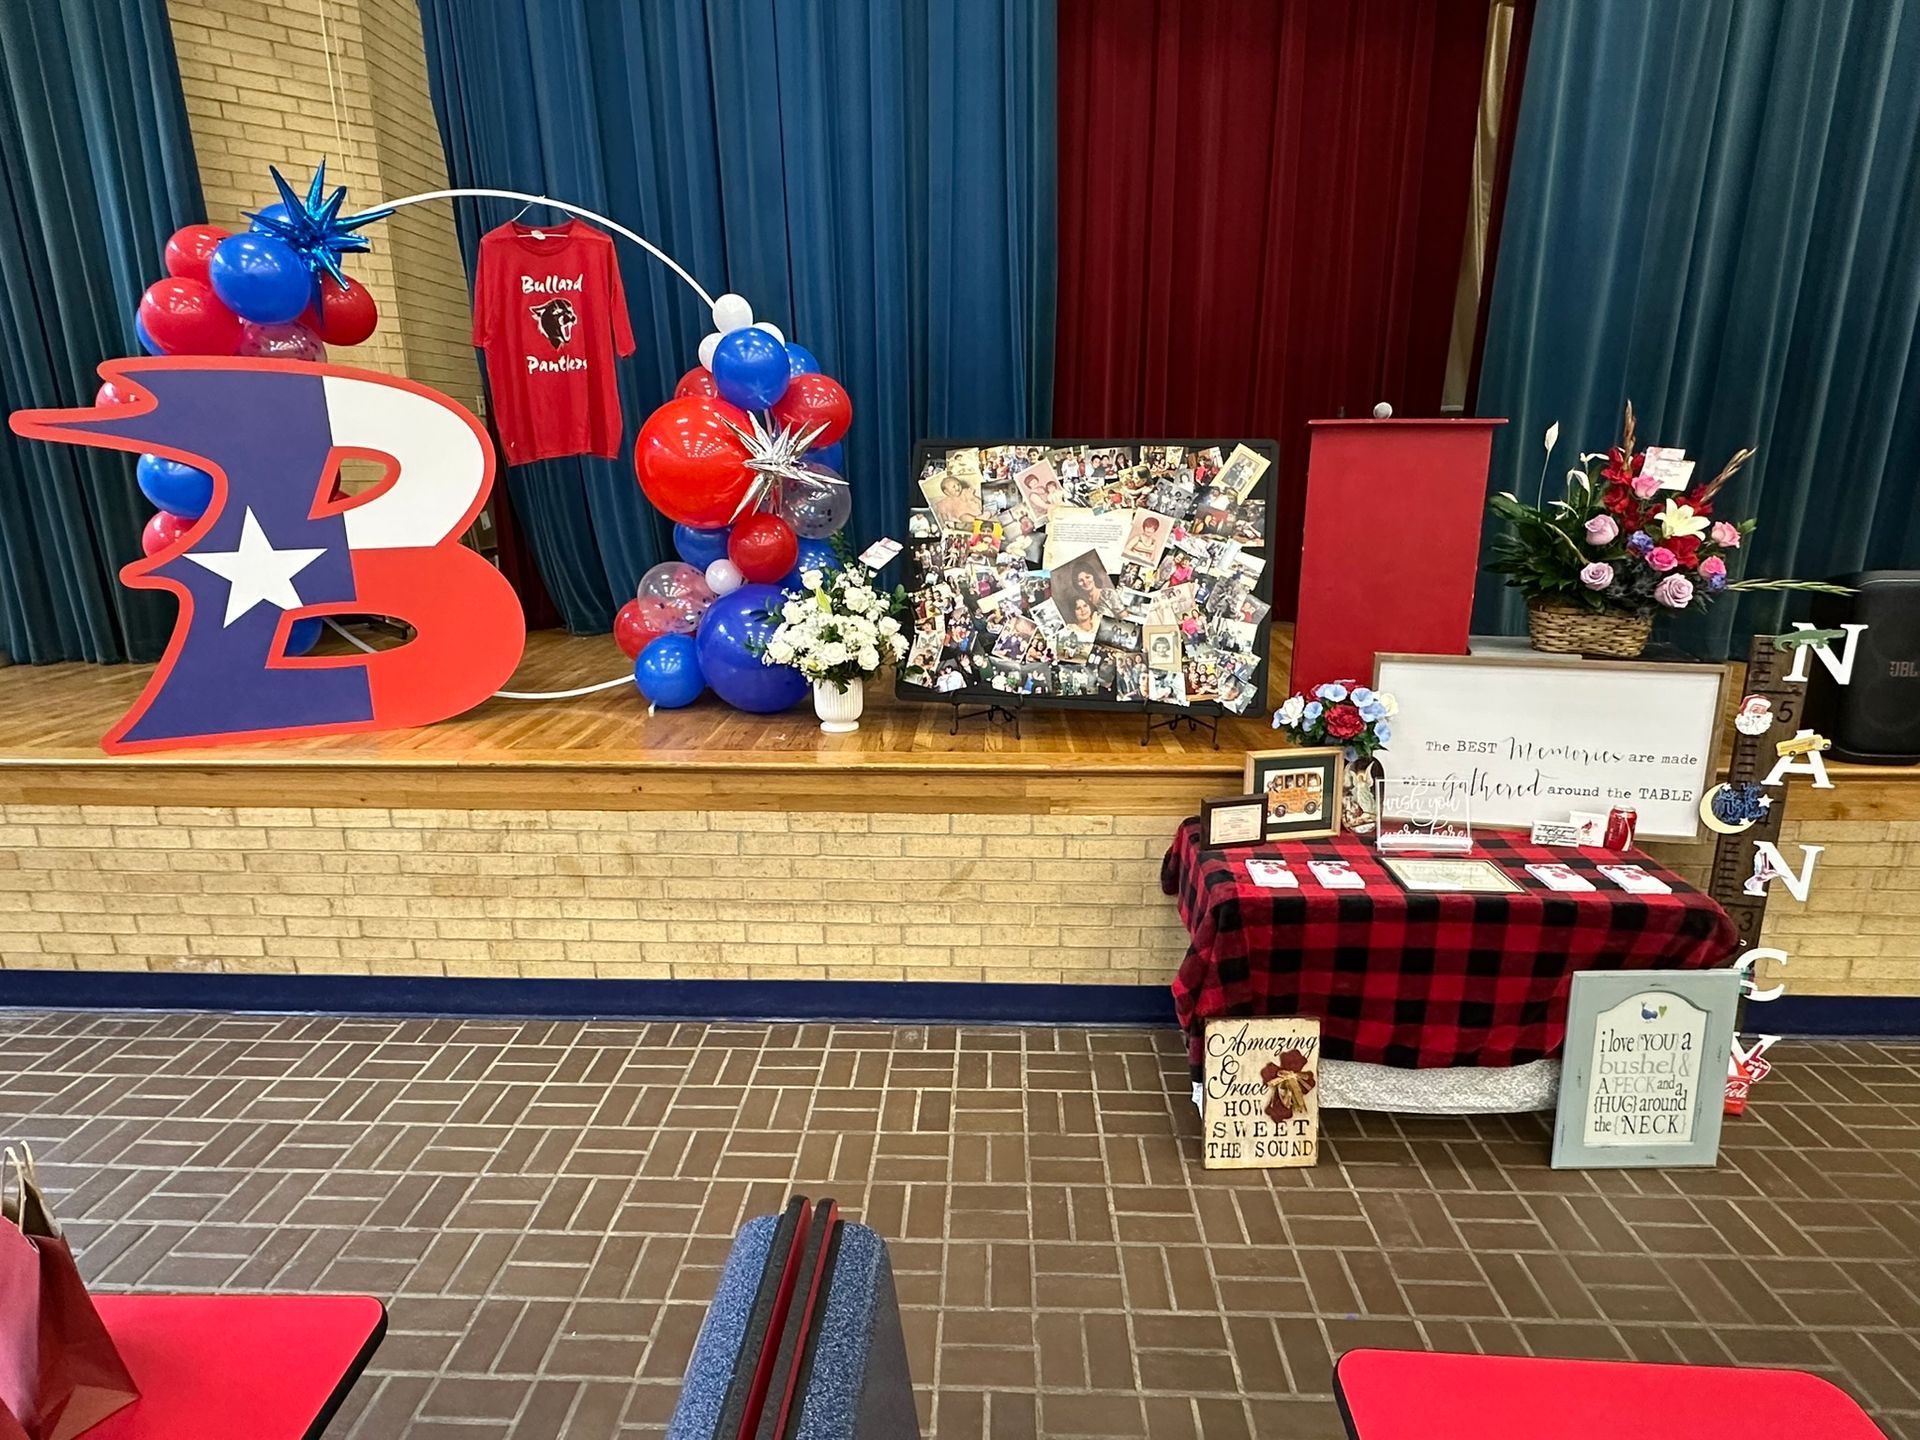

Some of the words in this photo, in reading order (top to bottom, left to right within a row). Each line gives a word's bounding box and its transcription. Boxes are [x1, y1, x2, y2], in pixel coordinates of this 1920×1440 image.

[521, 274, 583, 294] Bullard
[1889, 661, 1918, 677] JBL
[1776, 701, 1794, 724] 5
[1425, 741, 1450, 752] The
[1457, 740, 1498, 754] BEST
[1502, 736, 1624, 766] Memories
[1628, 753, 1655, 763] are
[1661, 754, 1698, 765] made
[1547, 786, 1599, 797] around
[1607, 788, 1632, 799] the
[1639, 787, 1693, 802] TABLE
[1739, 911, 1755, 932] 3
[1207, 1022, 1318, 1059] Amazing
[1608, 1028, 1635, 1052] love
[1681, 1032, 1692, 1051] a
[1599, 1053, 1676, 1075] bushel
[1678, 1053, 1690, 1077] &
[1208, 1055, 1269, 1099] Grace
[1596, 1077, 1610, 1094] A
[1657, 1074, 1676, 1090] and
[1675, 1082, 1683, 1096] a
[1224, 1099, 1264, 1117] HOW
[1639, 1089, 1688, 1112] around
[1212, 1120, 1310, 1138] SWEET
[1594, 1115, 1612, 1132] the
[1207, 1142, 1242, 1159] THE
[1255, 1140, 1314, 1158] SOUND
